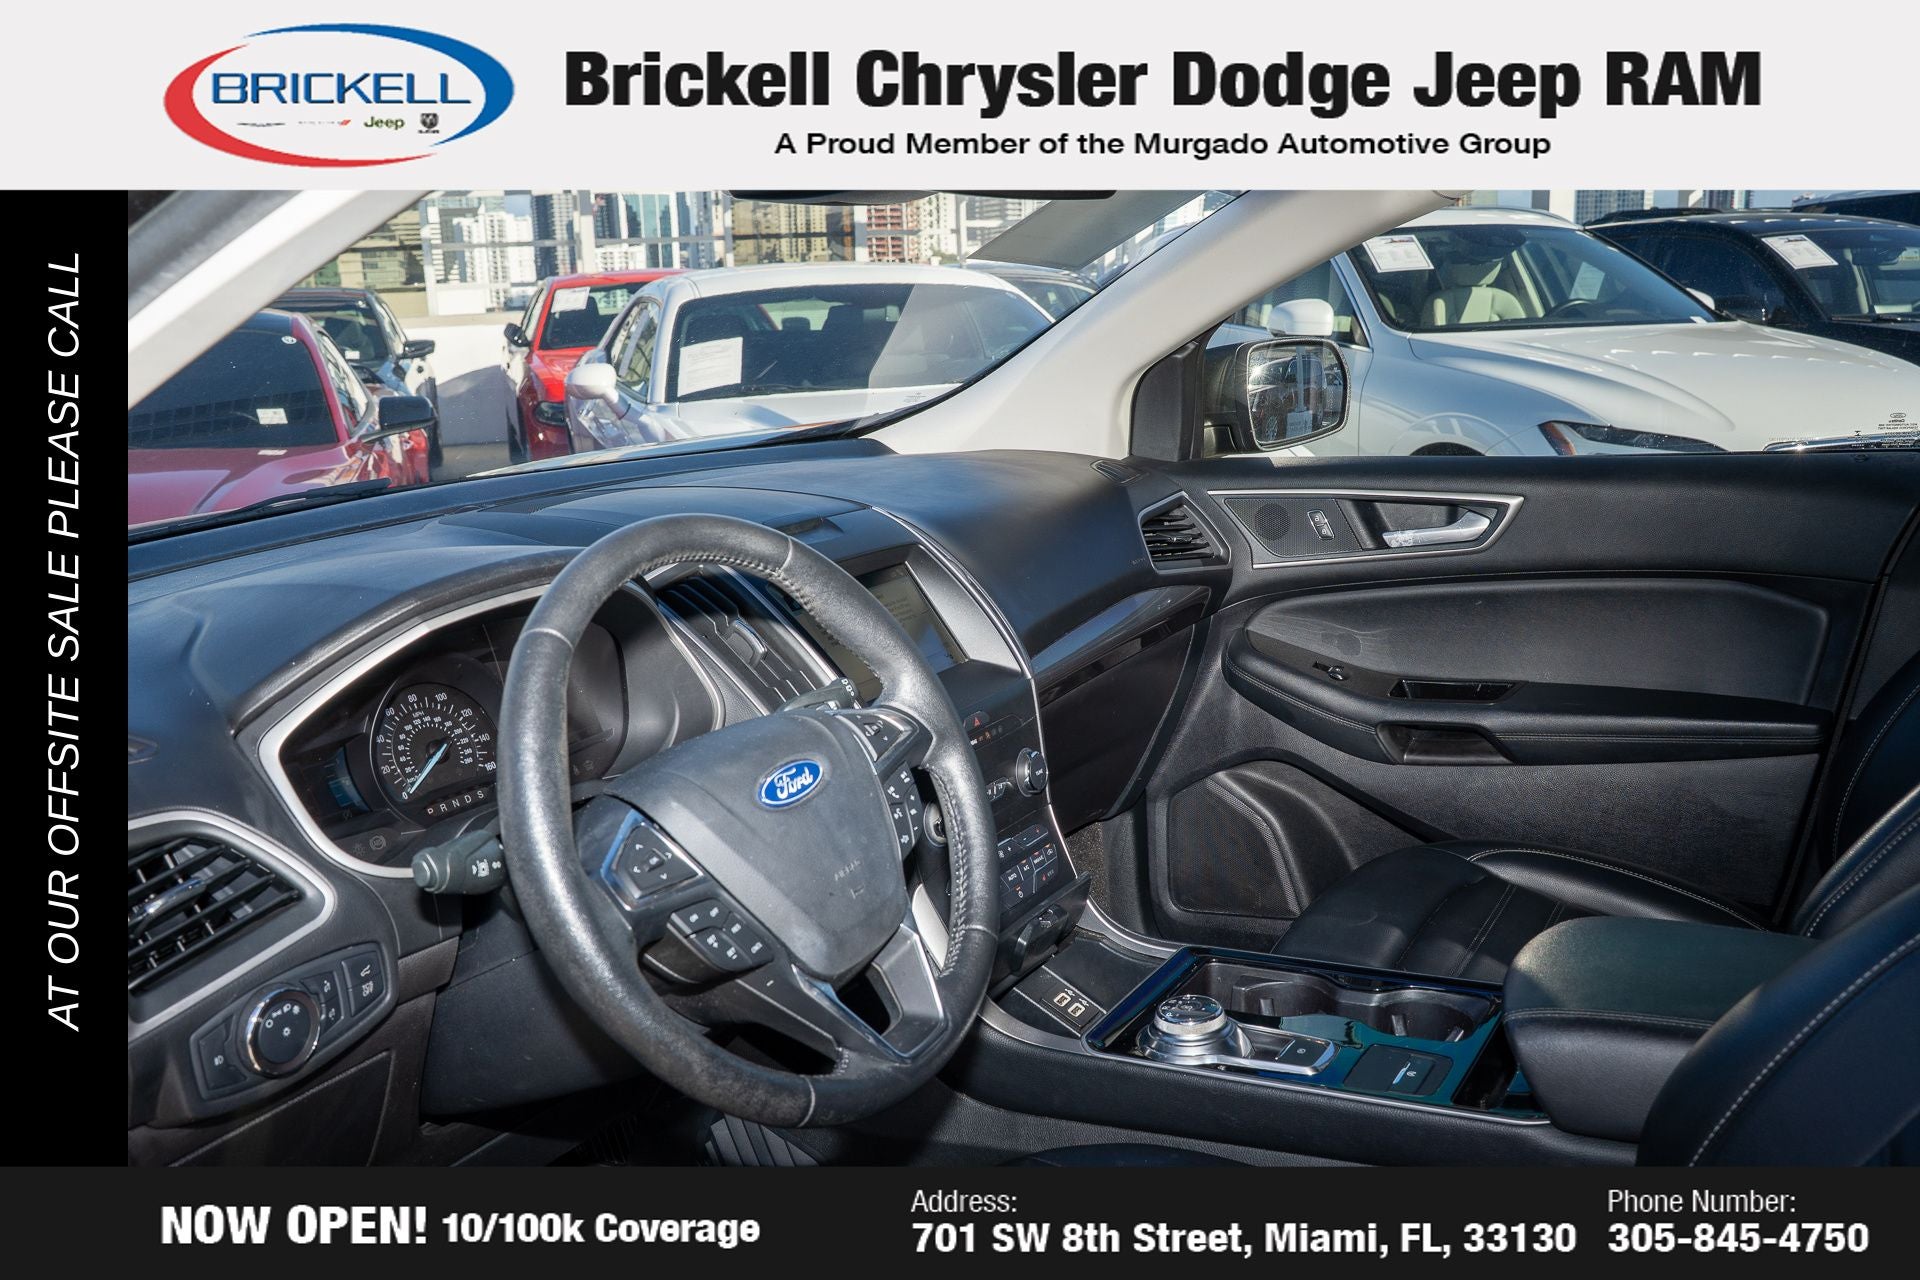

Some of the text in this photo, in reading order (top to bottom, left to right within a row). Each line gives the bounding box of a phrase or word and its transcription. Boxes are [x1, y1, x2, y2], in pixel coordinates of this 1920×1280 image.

[408, 694, 417, 702] 80
[435, 693, 447, 701] 100
[385, 707, 395, 717] 60
[461, 708, 472, 717] 120
[376, 735, 385, 743] 40
[479, 733, 490, 742] 140
[381, 765, 391, 774] 20
[485, 761, 497, 771] 160
[774, 766, 814, 799] Ford
[440, 803, 448, 812] R
[452, 799, 460, 808] N
[464, 795, 472, 803] D
[477, 790, 484, 799] S
